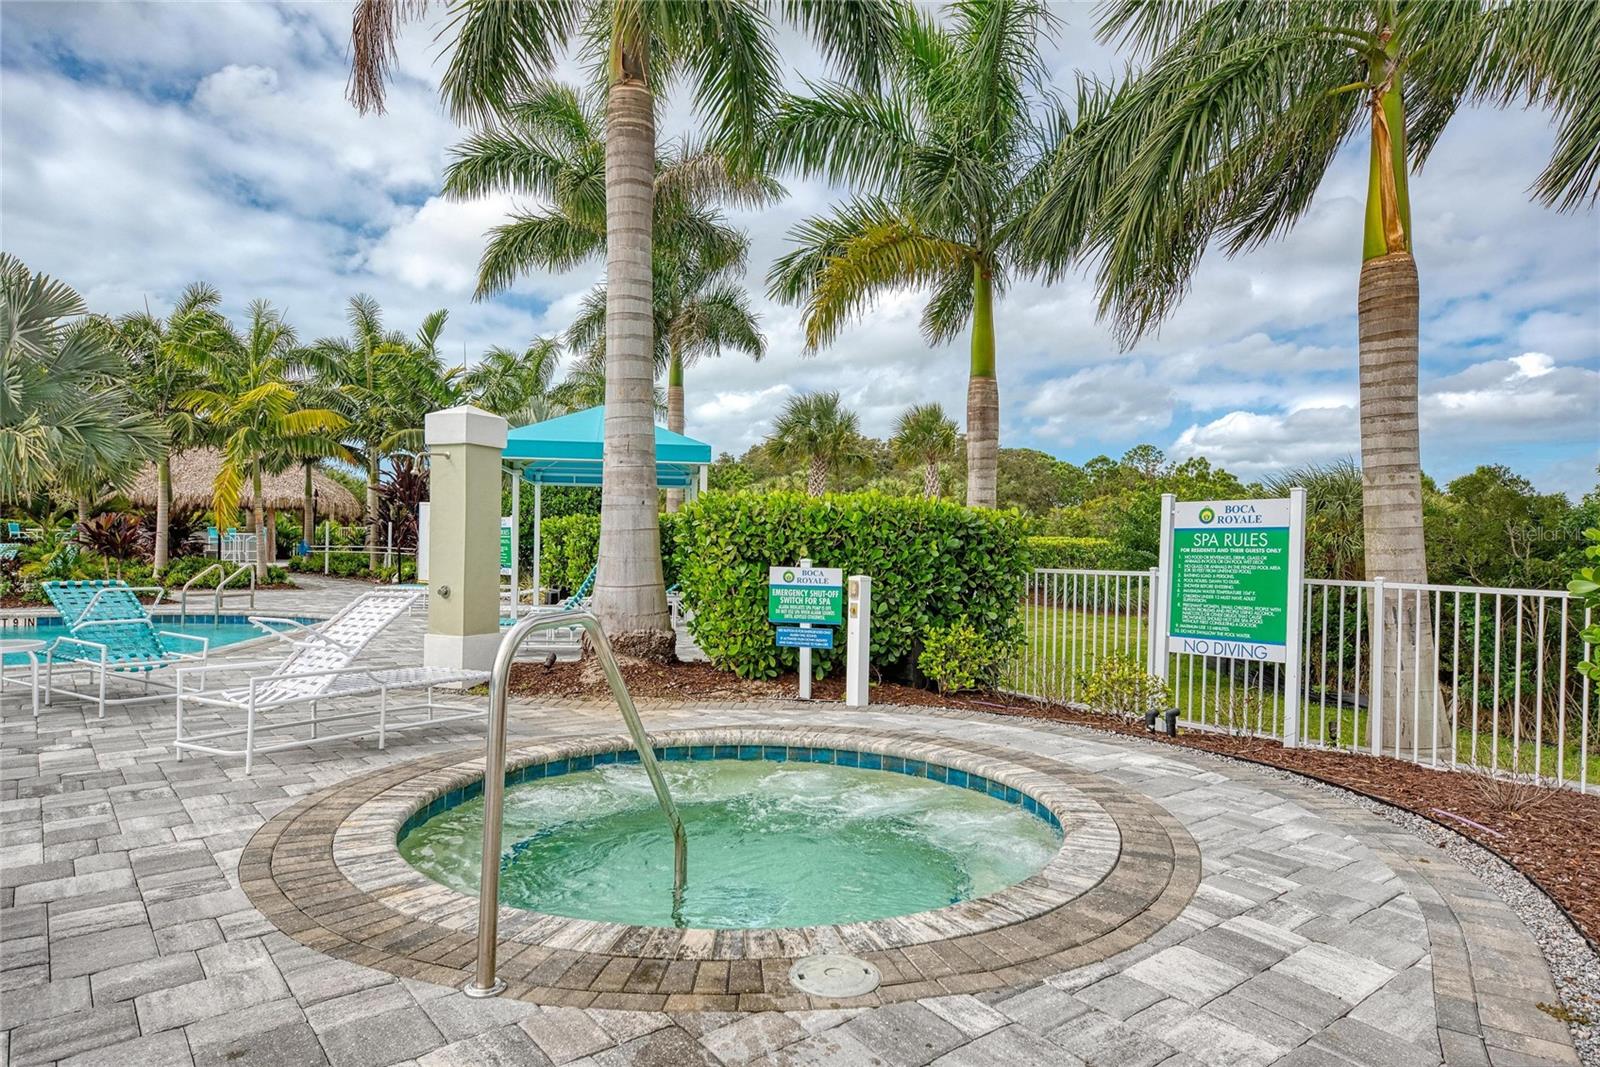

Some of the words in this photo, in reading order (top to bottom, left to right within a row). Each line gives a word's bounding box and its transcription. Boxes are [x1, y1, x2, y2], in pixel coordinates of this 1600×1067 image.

[1225, 505, 1256, 514] BOCA
[1217, 515, 1262, 524] ROYALE
[1193, 533, 1219, 546] SPA
[1224, 533, 1268, 547] RULES
[772, 589, 808, 597] EMERGENCY
[810, 590, 838, 598] SHUT-OFF
[24, 618, 35, 627] IN
[1184, 640, 1209, 654] NO
[1214, 642, 1268, 660] DIVING
